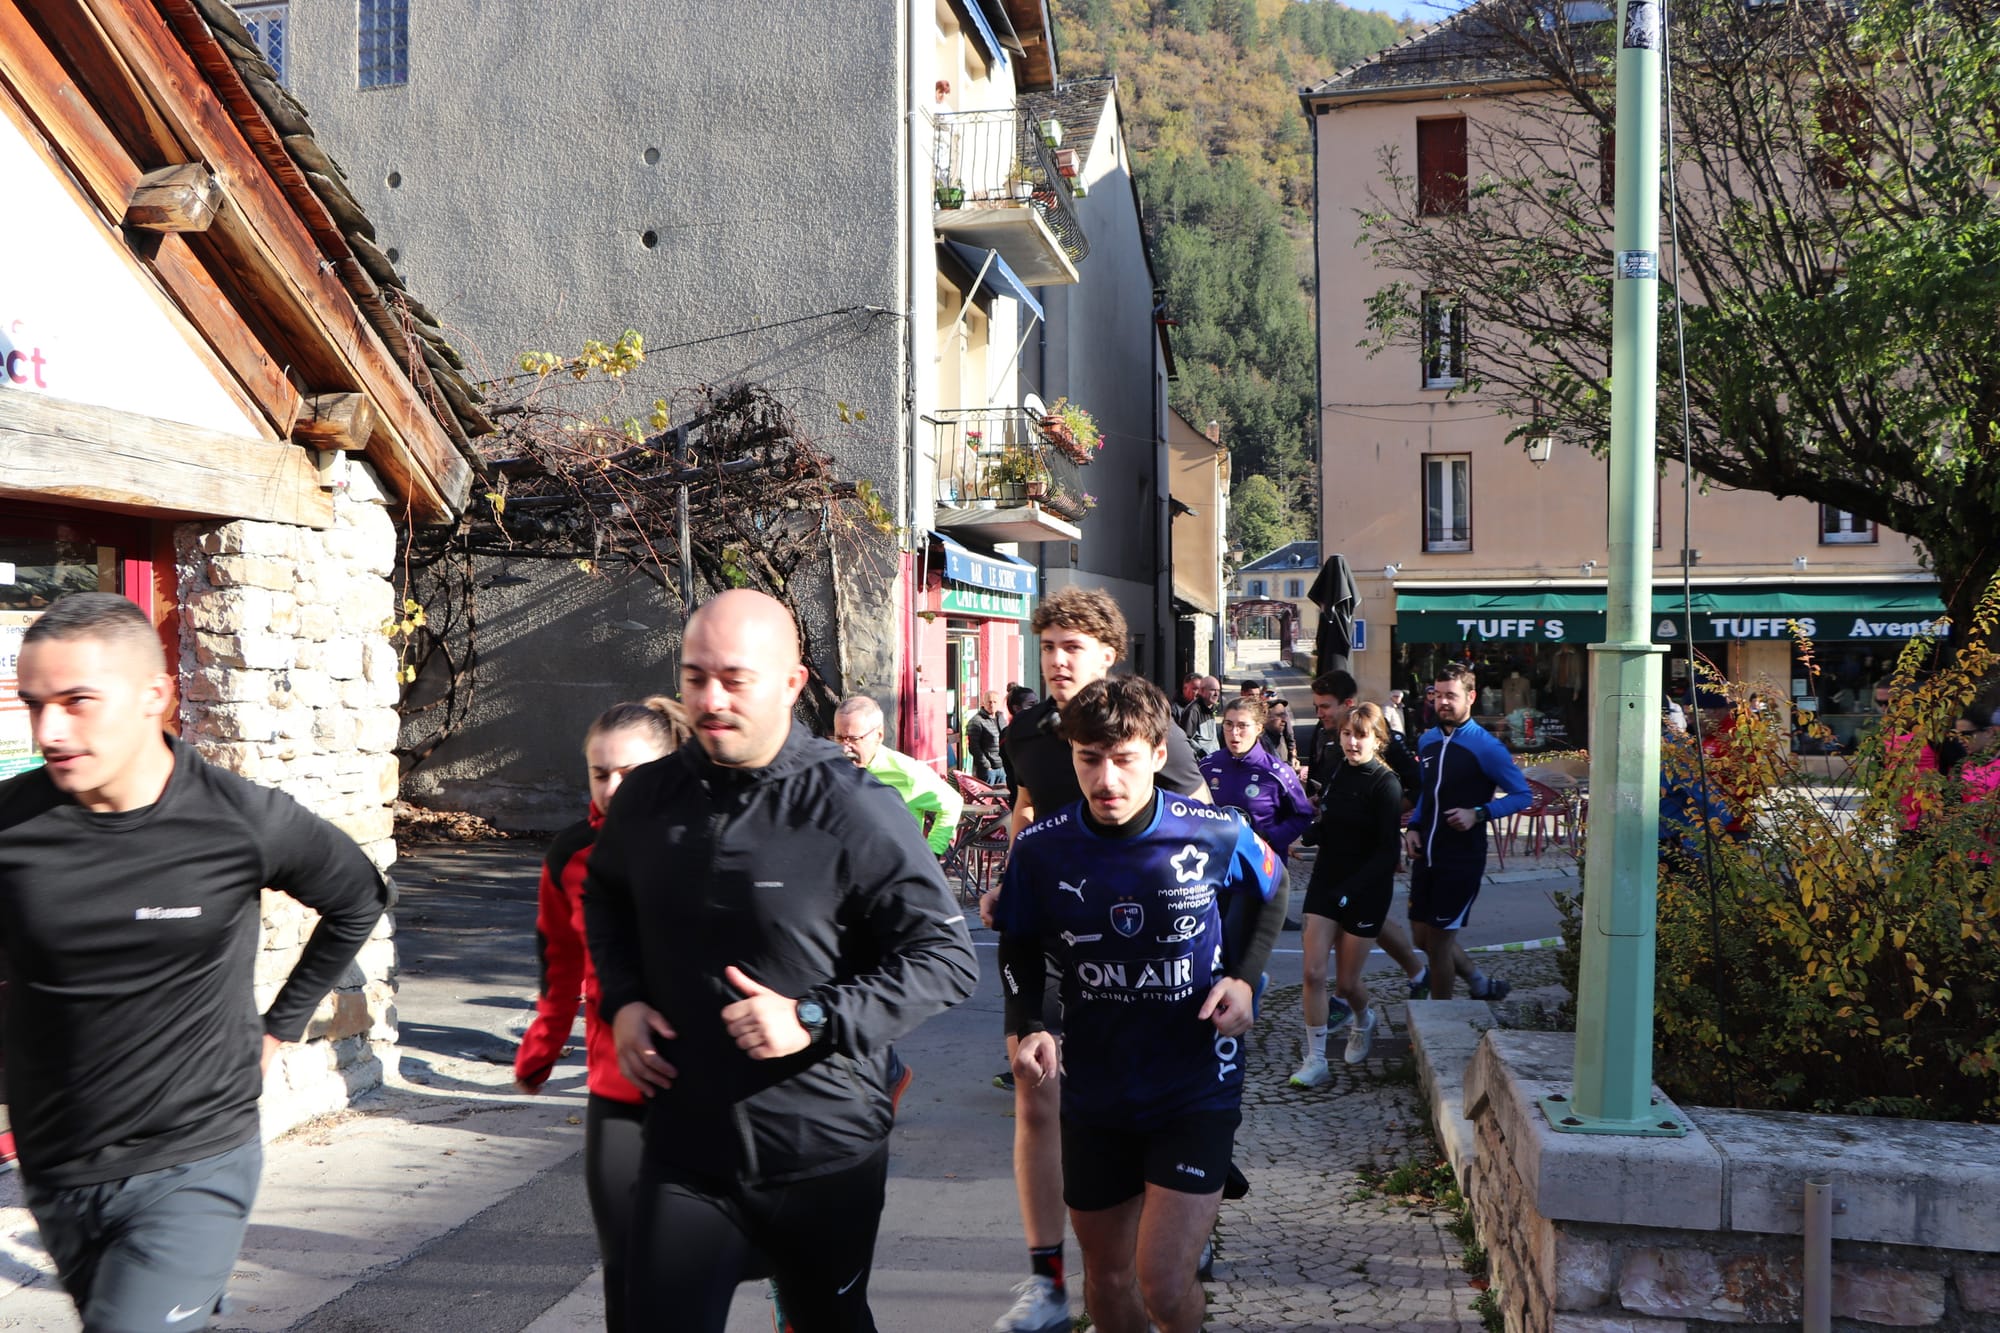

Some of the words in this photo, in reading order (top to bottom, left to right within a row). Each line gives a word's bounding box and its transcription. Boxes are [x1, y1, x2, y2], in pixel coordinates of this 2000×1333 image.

[0, 347, 47, 389] ct
[1457, 619, 1564, 638] TUFF'S
[1710, 617, 1817, 637] TUFFS
[1188, 807, 1232, 822] VEOLIA
[1078, 962, 1127, 987] ON
[1135, 959, 1191, 989] AIR
